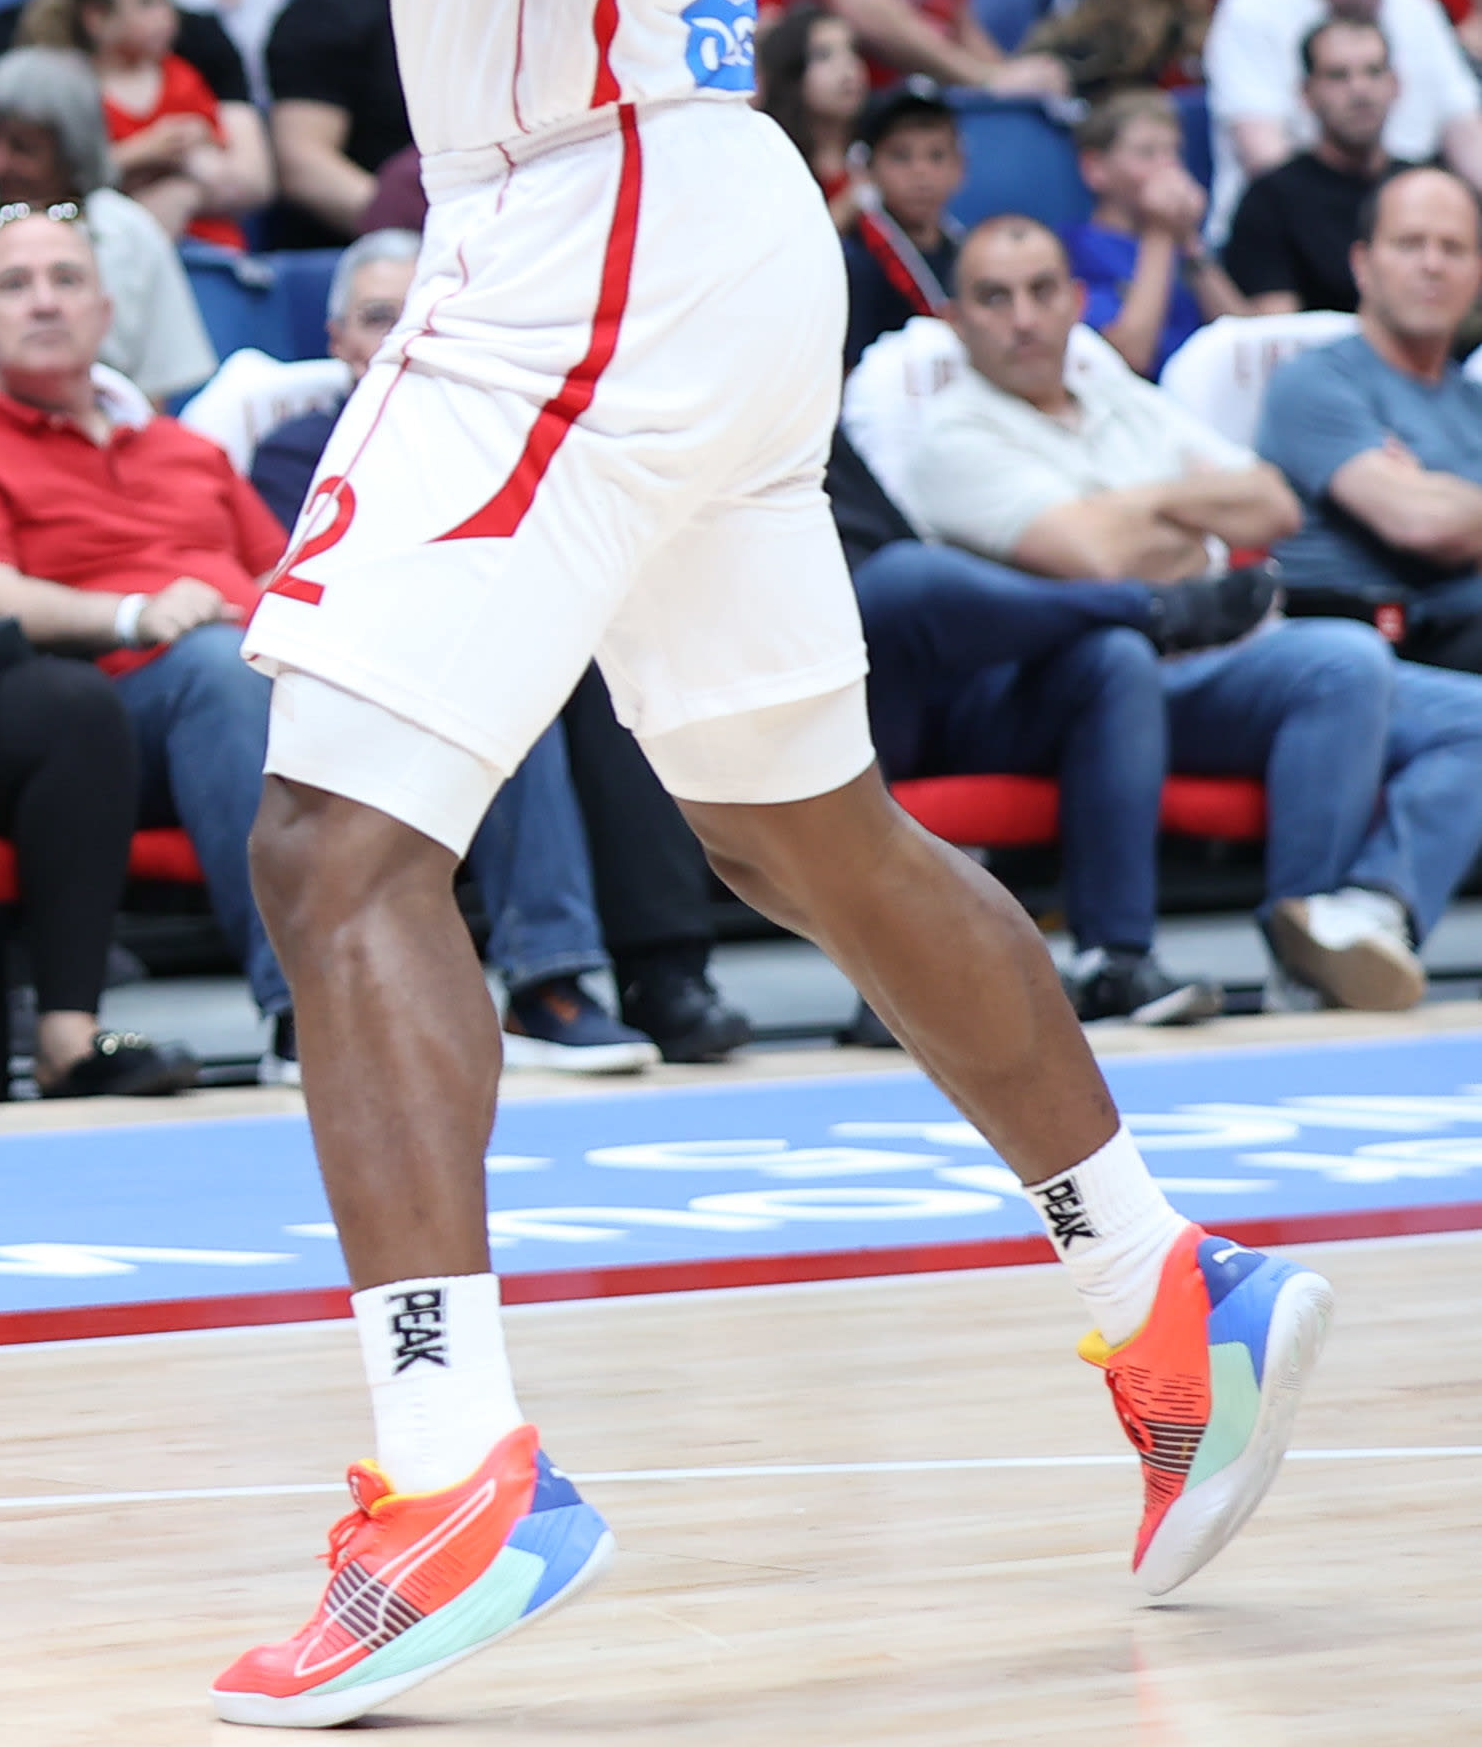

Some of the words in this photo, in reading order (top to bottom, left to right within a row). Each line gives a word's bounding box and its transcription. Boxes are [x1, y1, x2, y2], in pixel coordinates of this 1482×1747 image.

[266, 475, 357, 606] 2
[1034, 1178, 1100, 1251] PEAK
[384, 1287, 451, 1376] PEAK
